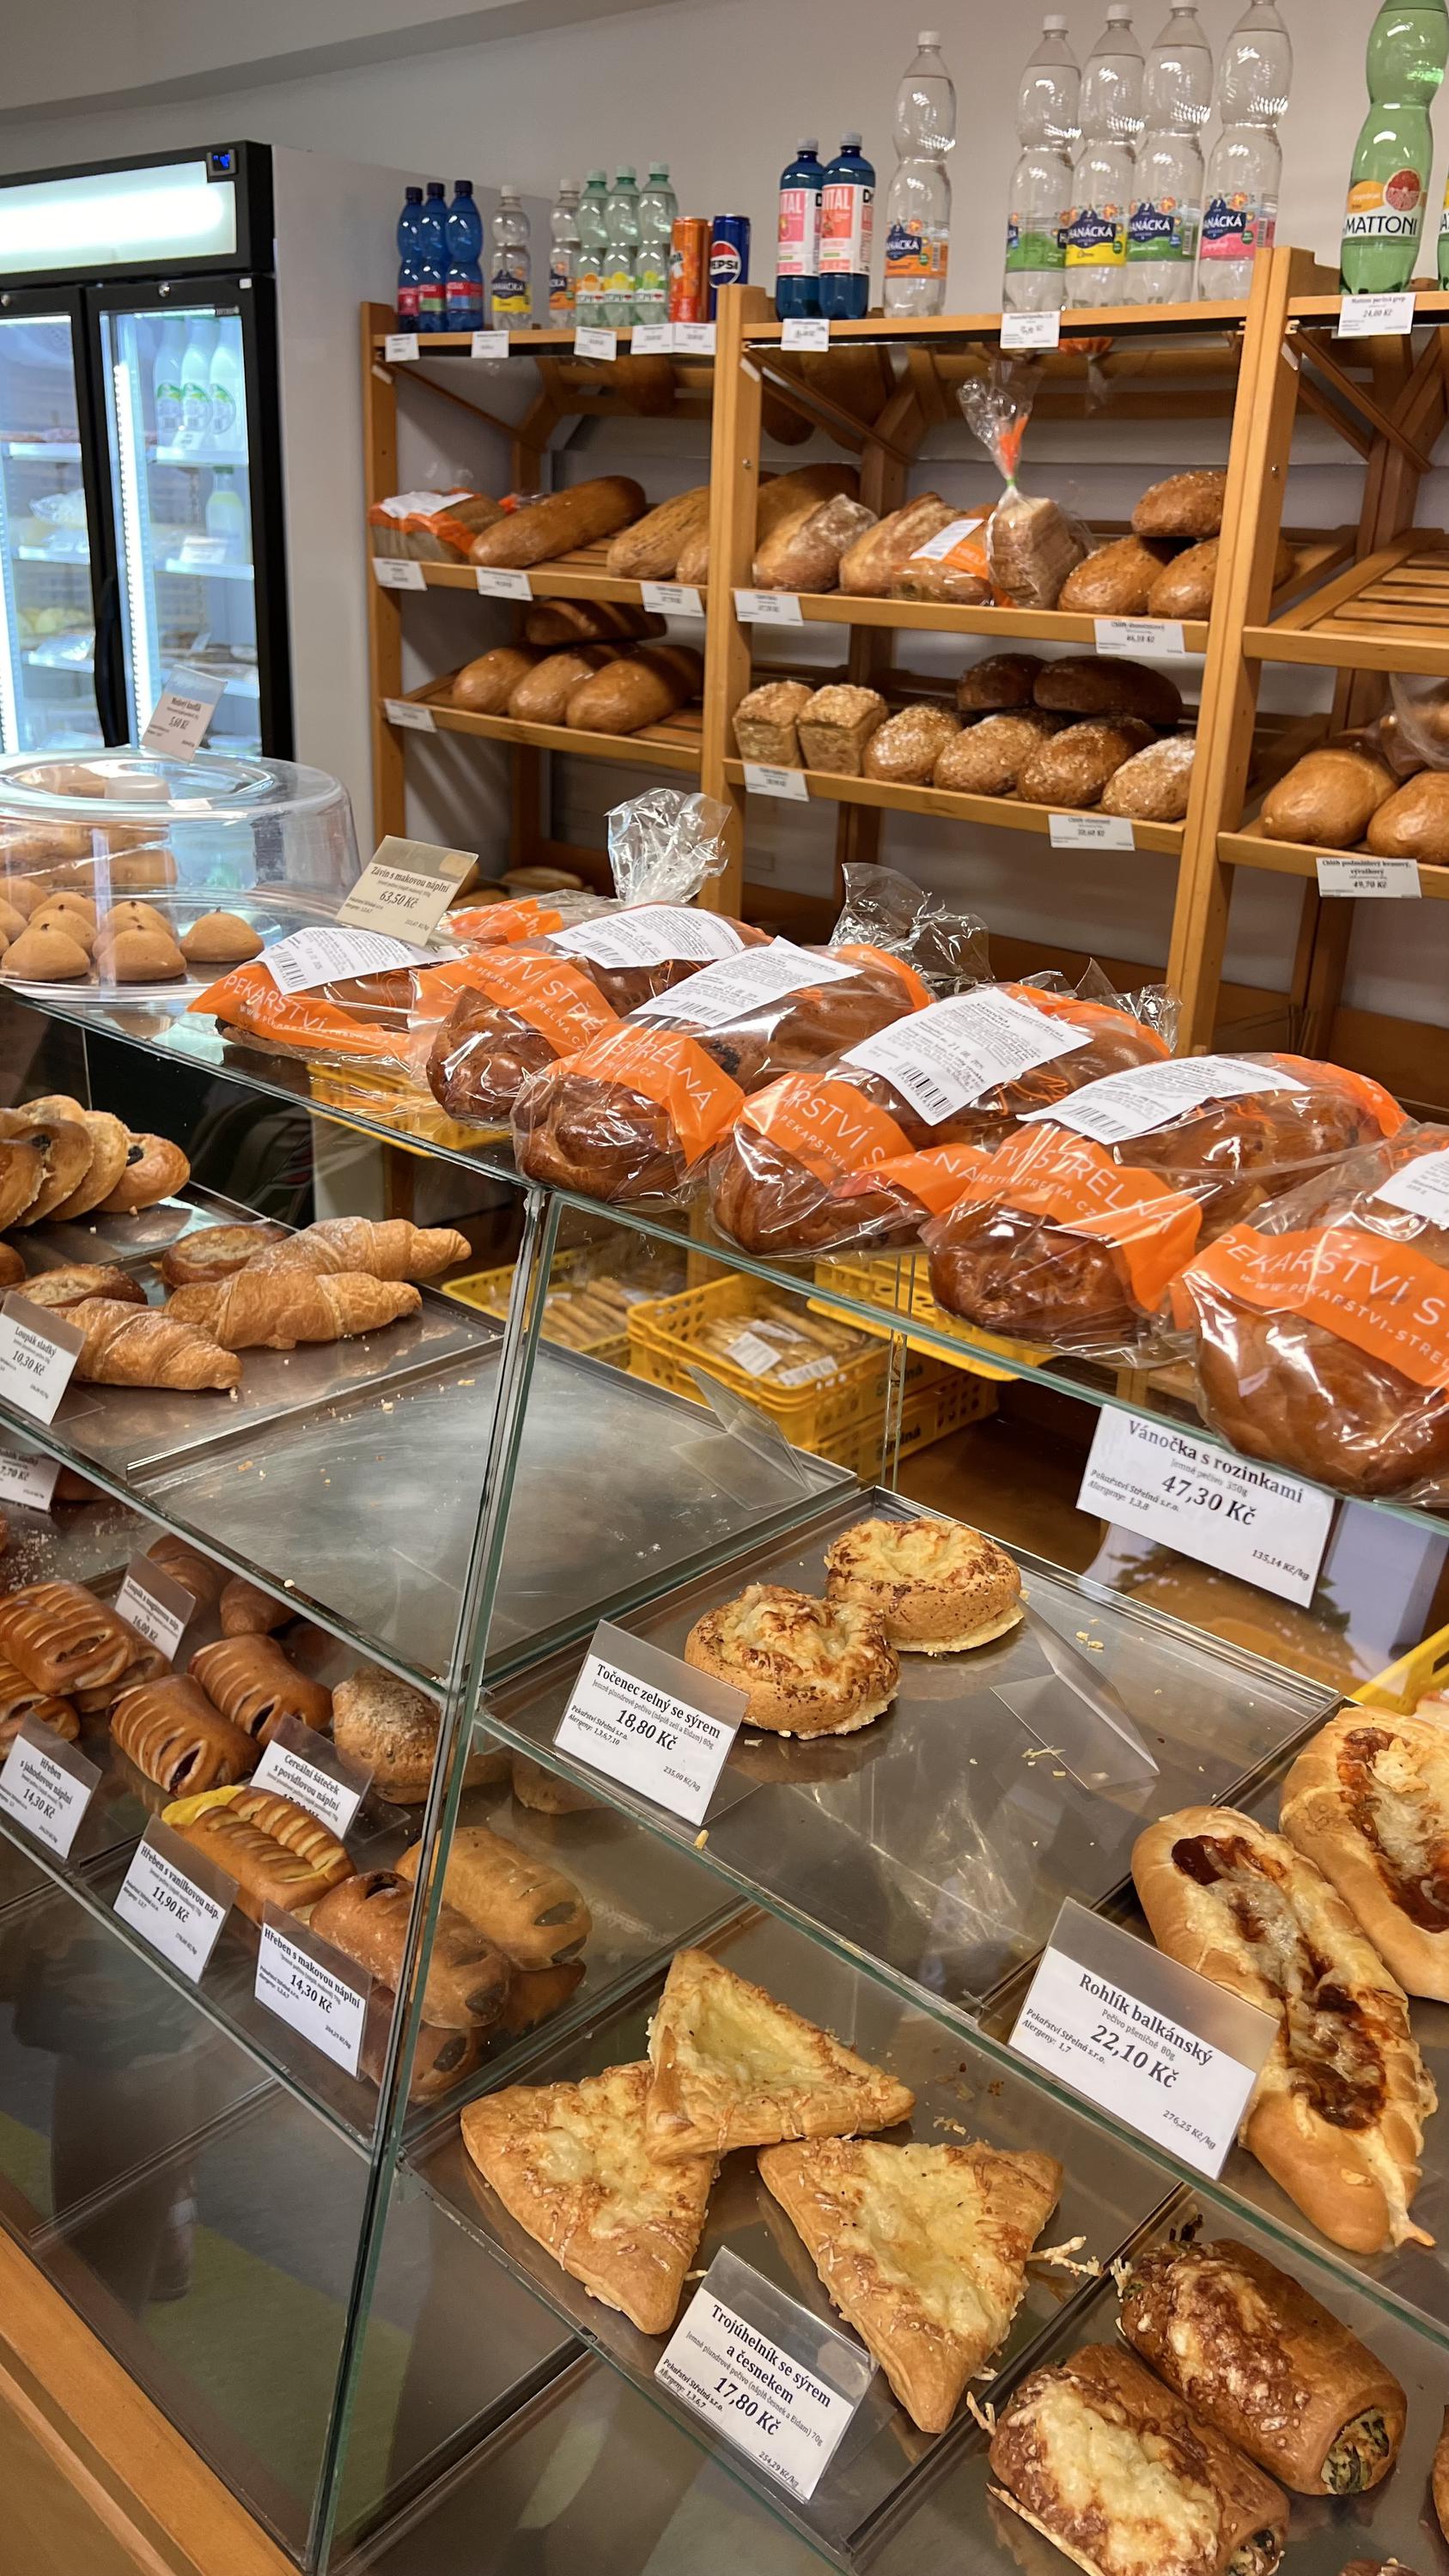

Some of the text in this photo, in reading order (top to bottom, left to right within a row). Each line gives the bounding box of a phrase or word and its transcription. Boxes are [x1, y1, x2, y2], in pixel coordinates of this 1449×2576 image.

[1346, 216, 1417, 235] MATTONI
[711, 260, 738, 269] EPSI
[370, 866, 390, 878] Závin
[393, 873, 426, 886] makovou
[425, 880, 450, 892] náplní
[379, 890, 419, 908] 63,50 Kč
[12, 1350, 46, 1376] 10,30 Kč
[1129, 1420, 1302, 1503] Vánočka s rozinkami
[1159, 1499, 1178, 1511] s.r.o.
[1162, 1475, 1256, 1525] 47,30 Kč
[1251, 1549, 1310, 1581] 135,14 Kč/kg
[571, 1704, 597, 1722] Pekařství
[595, 1717, 616, 1733] Střelná
[597, 1663, 720, 1738] Točenec zelný se sýrem
[568, 1713, 593, 1730] Alergeny:
[615, 1710, 678, 1750] 18,80 Kč
[284, 1754, 339, 1795] Cereální šáteček
[22, 1788, 45, 1810] 14,30
[43, 1803, 55, 1819] Kč
[52, 1785, 72, 1804] náplní
[315, 1791, 340, 1811] náplní
[140, 1845, 164, 1871] Hřeben
[168, 1871, 204, 1906] vanilkovou
[204, 1902, 218, 1919] náp.
[152, 1886, 177, 1911] 11,90
[174, 1905, 189, 1923] Kč
[264, 1927, 291, 1955] Hřeben
[297, 1955, 333, 1988] makovou
[334, 1984, 360, 2008] náplní
[290, 1974, 317, 2001] 14,30
[318, 1995, 332, 2013] Kč
[1021, 2019, 1071, 2052] Alergeny: 1,7
[1026, 2008, 1105, 2063] Pekařství Střelná s.r.o.
[1079, 1973, 1212, 2065] Rohlík balkánský
[1101, 2008, 1125, 2028] Pečivo
[1160, 2045, 1175, 2061] 80g
[1090, 2024, 1178, 2087] 22,10 Kč
[1162, 2110, 1215, 2149] 276,25 Kč/kg
[711, 2304, 830, 2407] Trojúhelník se sýrem
[726, 2345, 793, 2404] a česnekem
[663, 2358, 722, 2411] Pekařství Střelná s.r.o.
[713, 2377, 781, 2434] 17,80 Kč
